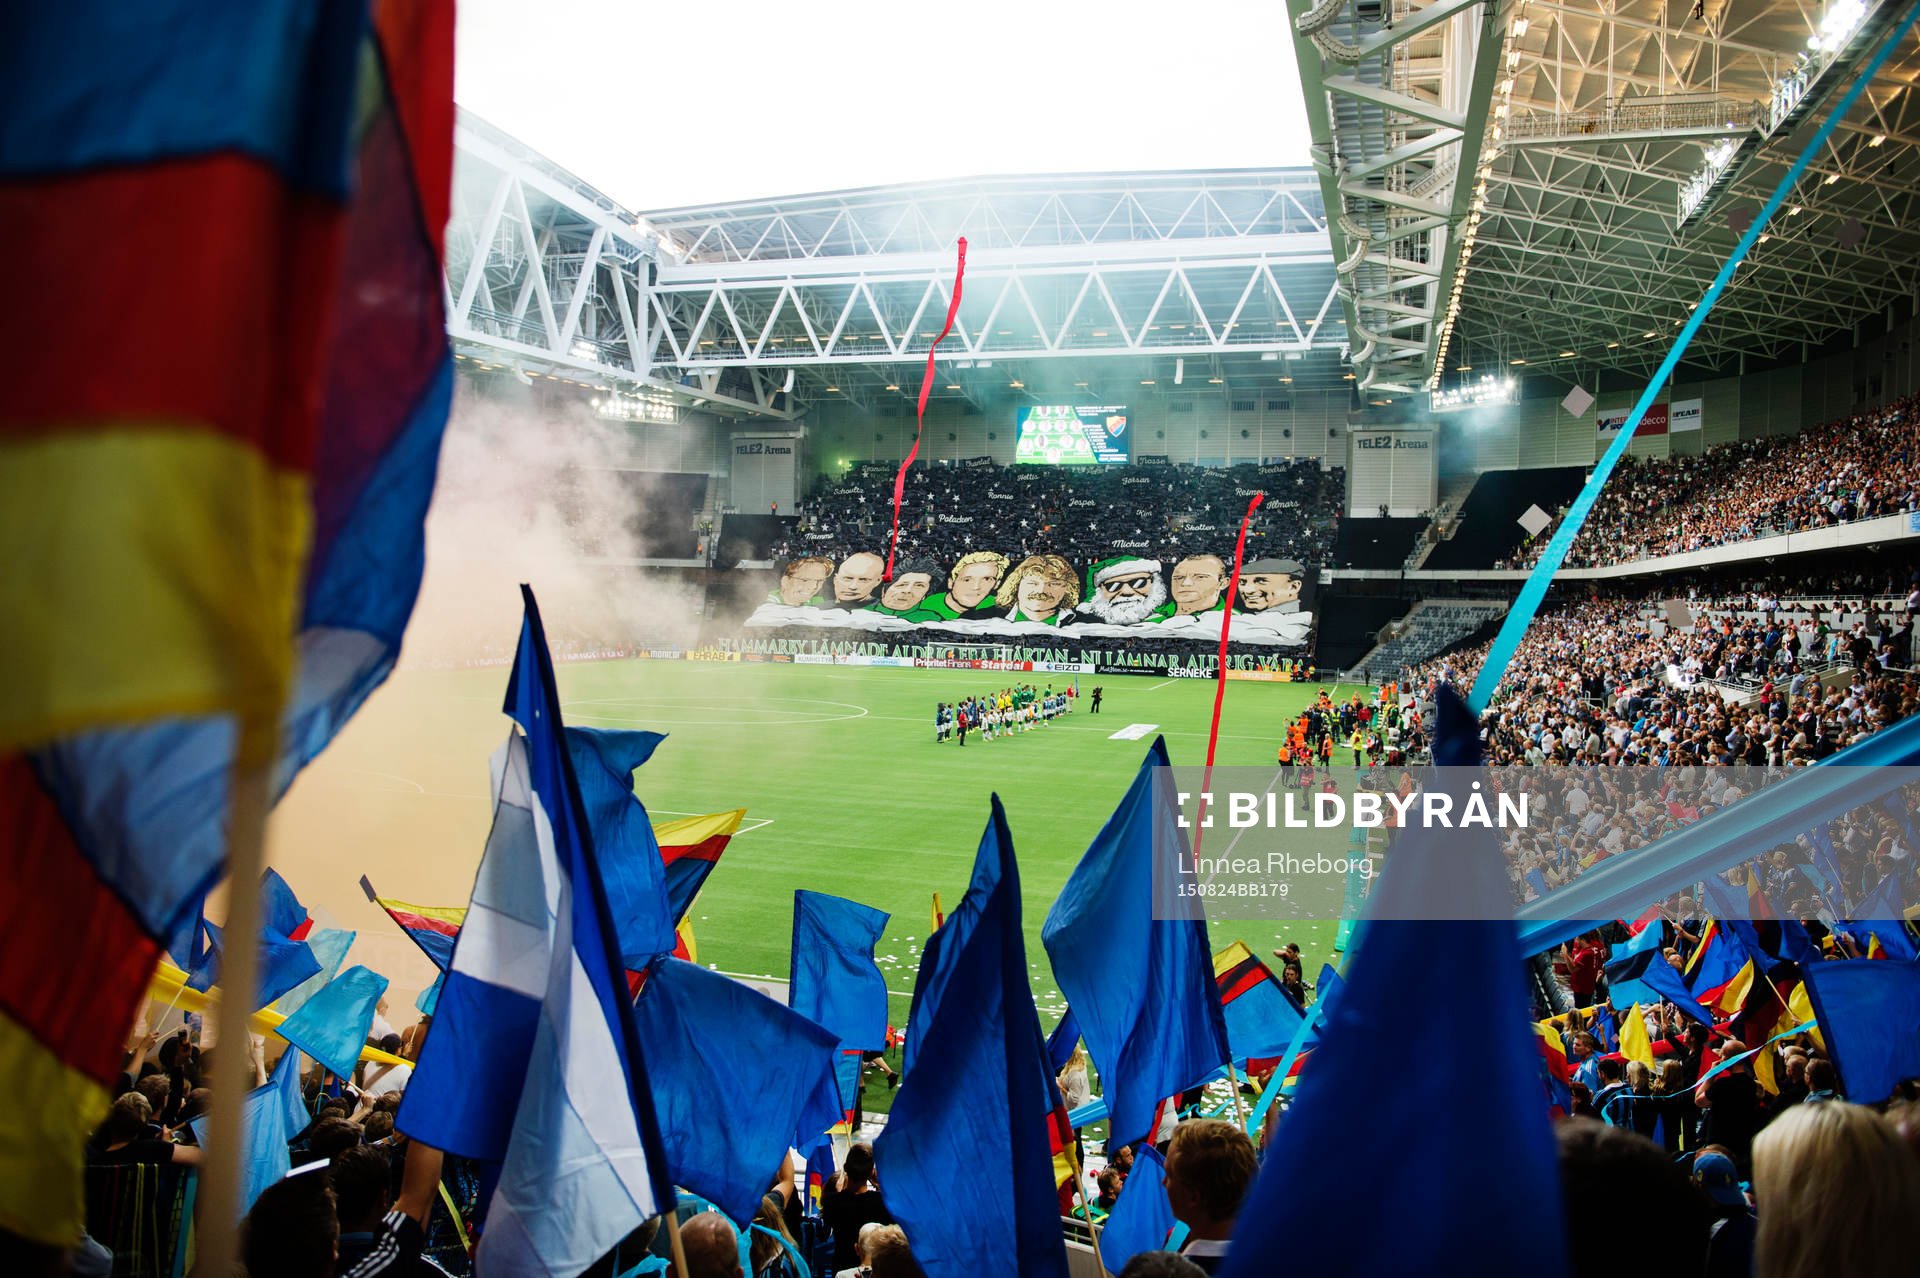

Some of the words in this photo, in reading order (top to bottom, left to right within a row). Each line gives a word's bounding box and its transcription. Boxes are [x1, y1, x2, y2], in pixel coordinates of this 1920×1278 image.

[1640, 416, 1666, 426] decco
[1357, 435, 1392, 449] TELE2
[1394, 438, 1428, 449] Arena
[736, 442, 763, 455] TELE2
[764, 445, 791, 455] Arena
[1068, 497, 1096, 508] Jesper
[1111, 539, 1150, 549] Michael
[1167, 667, 1213, 678] SERNEKE
